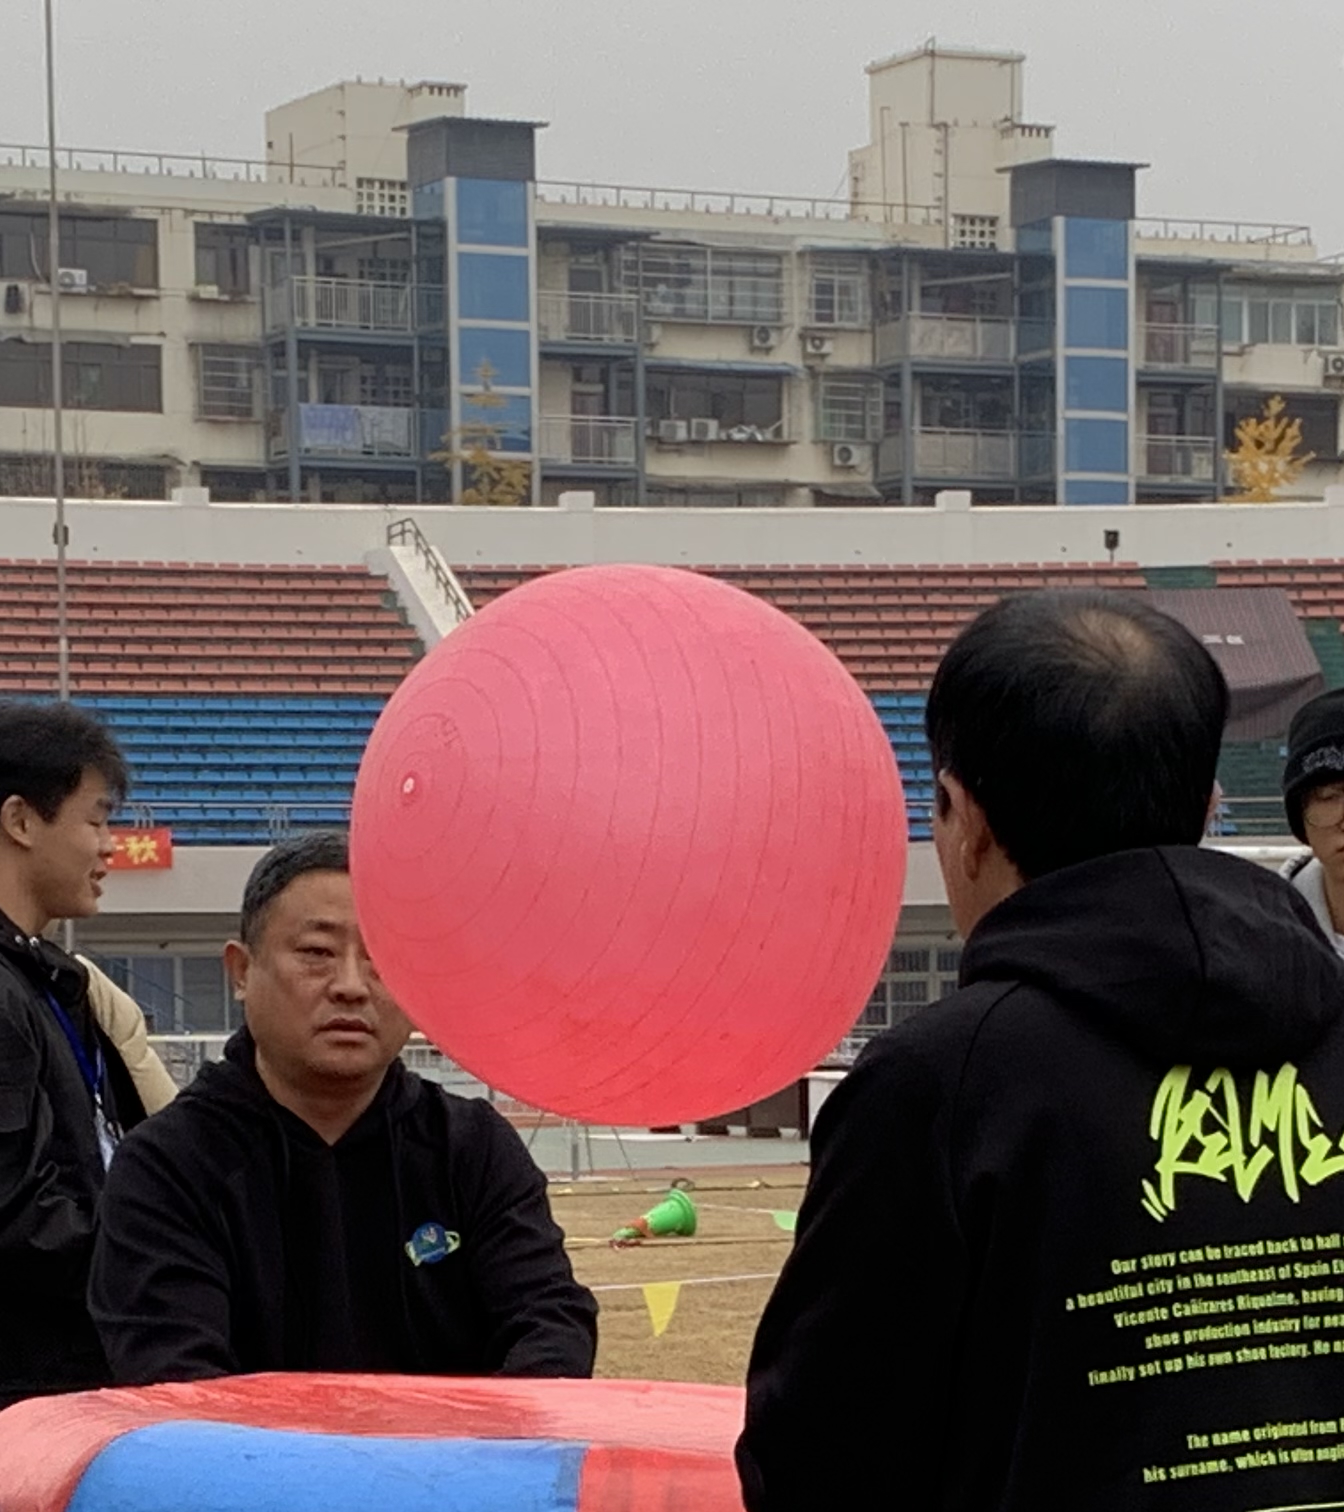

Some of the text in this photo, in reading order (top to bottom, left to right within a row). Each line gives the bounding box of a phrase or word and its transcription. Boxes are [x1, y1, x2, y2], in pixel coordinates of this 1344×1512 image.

[1111, 1259, 1137, 1274] Our
[1141, 1253, 1176, 1270] story
[1179, 1248, 1206, 1263] can
[1223, 1241, 1265, 1258] traced
[1266, 1238, 1299, 1254] back
[1300, 1237, 1314, 1251] to
[1066, 1298, 1075, 1310] a
[1077, 1283, 1144, 1308] beautiful
[1147, 1279, 1173, 1295] city
[1176, 1275, 1192, 1289] in
[1193, 1273, 1214, 1288] the
[1216, 1266, 1276, 1285] southeast
[1278, 1264, 1291, 1279] of
[1293, 1260, 1330, 1278] Spain
[1114, 1307, 1168, 1327] Vicente
[1302, 1287, 1344, 1303] having
[1145, 1332, 1180, 1349] shoe
[1183, 1323, 1251, 1344] production
[1252, 1318, 1300, 1334] industry
[1089, 1366, 1135, 1386] finally
[1139, 1361, 1161, 1377] set
[1164, 1358, 1183, 1372] up
[1186, 1352, 1206, 1369] his
[1208, 1351, 1233, 1366] own
[1236, 1347, 1267, 1363] shoe
[1313, 1340, 1330, 1354] He
[1187, 1434, 1209, 1449] The
[1212, 1430, 1251, 1445] name
[1310, 1420, 1337, 1434] from
[1143, 1466, 1166, 1482] his
[1235, 1450, 1277, 1469] which
